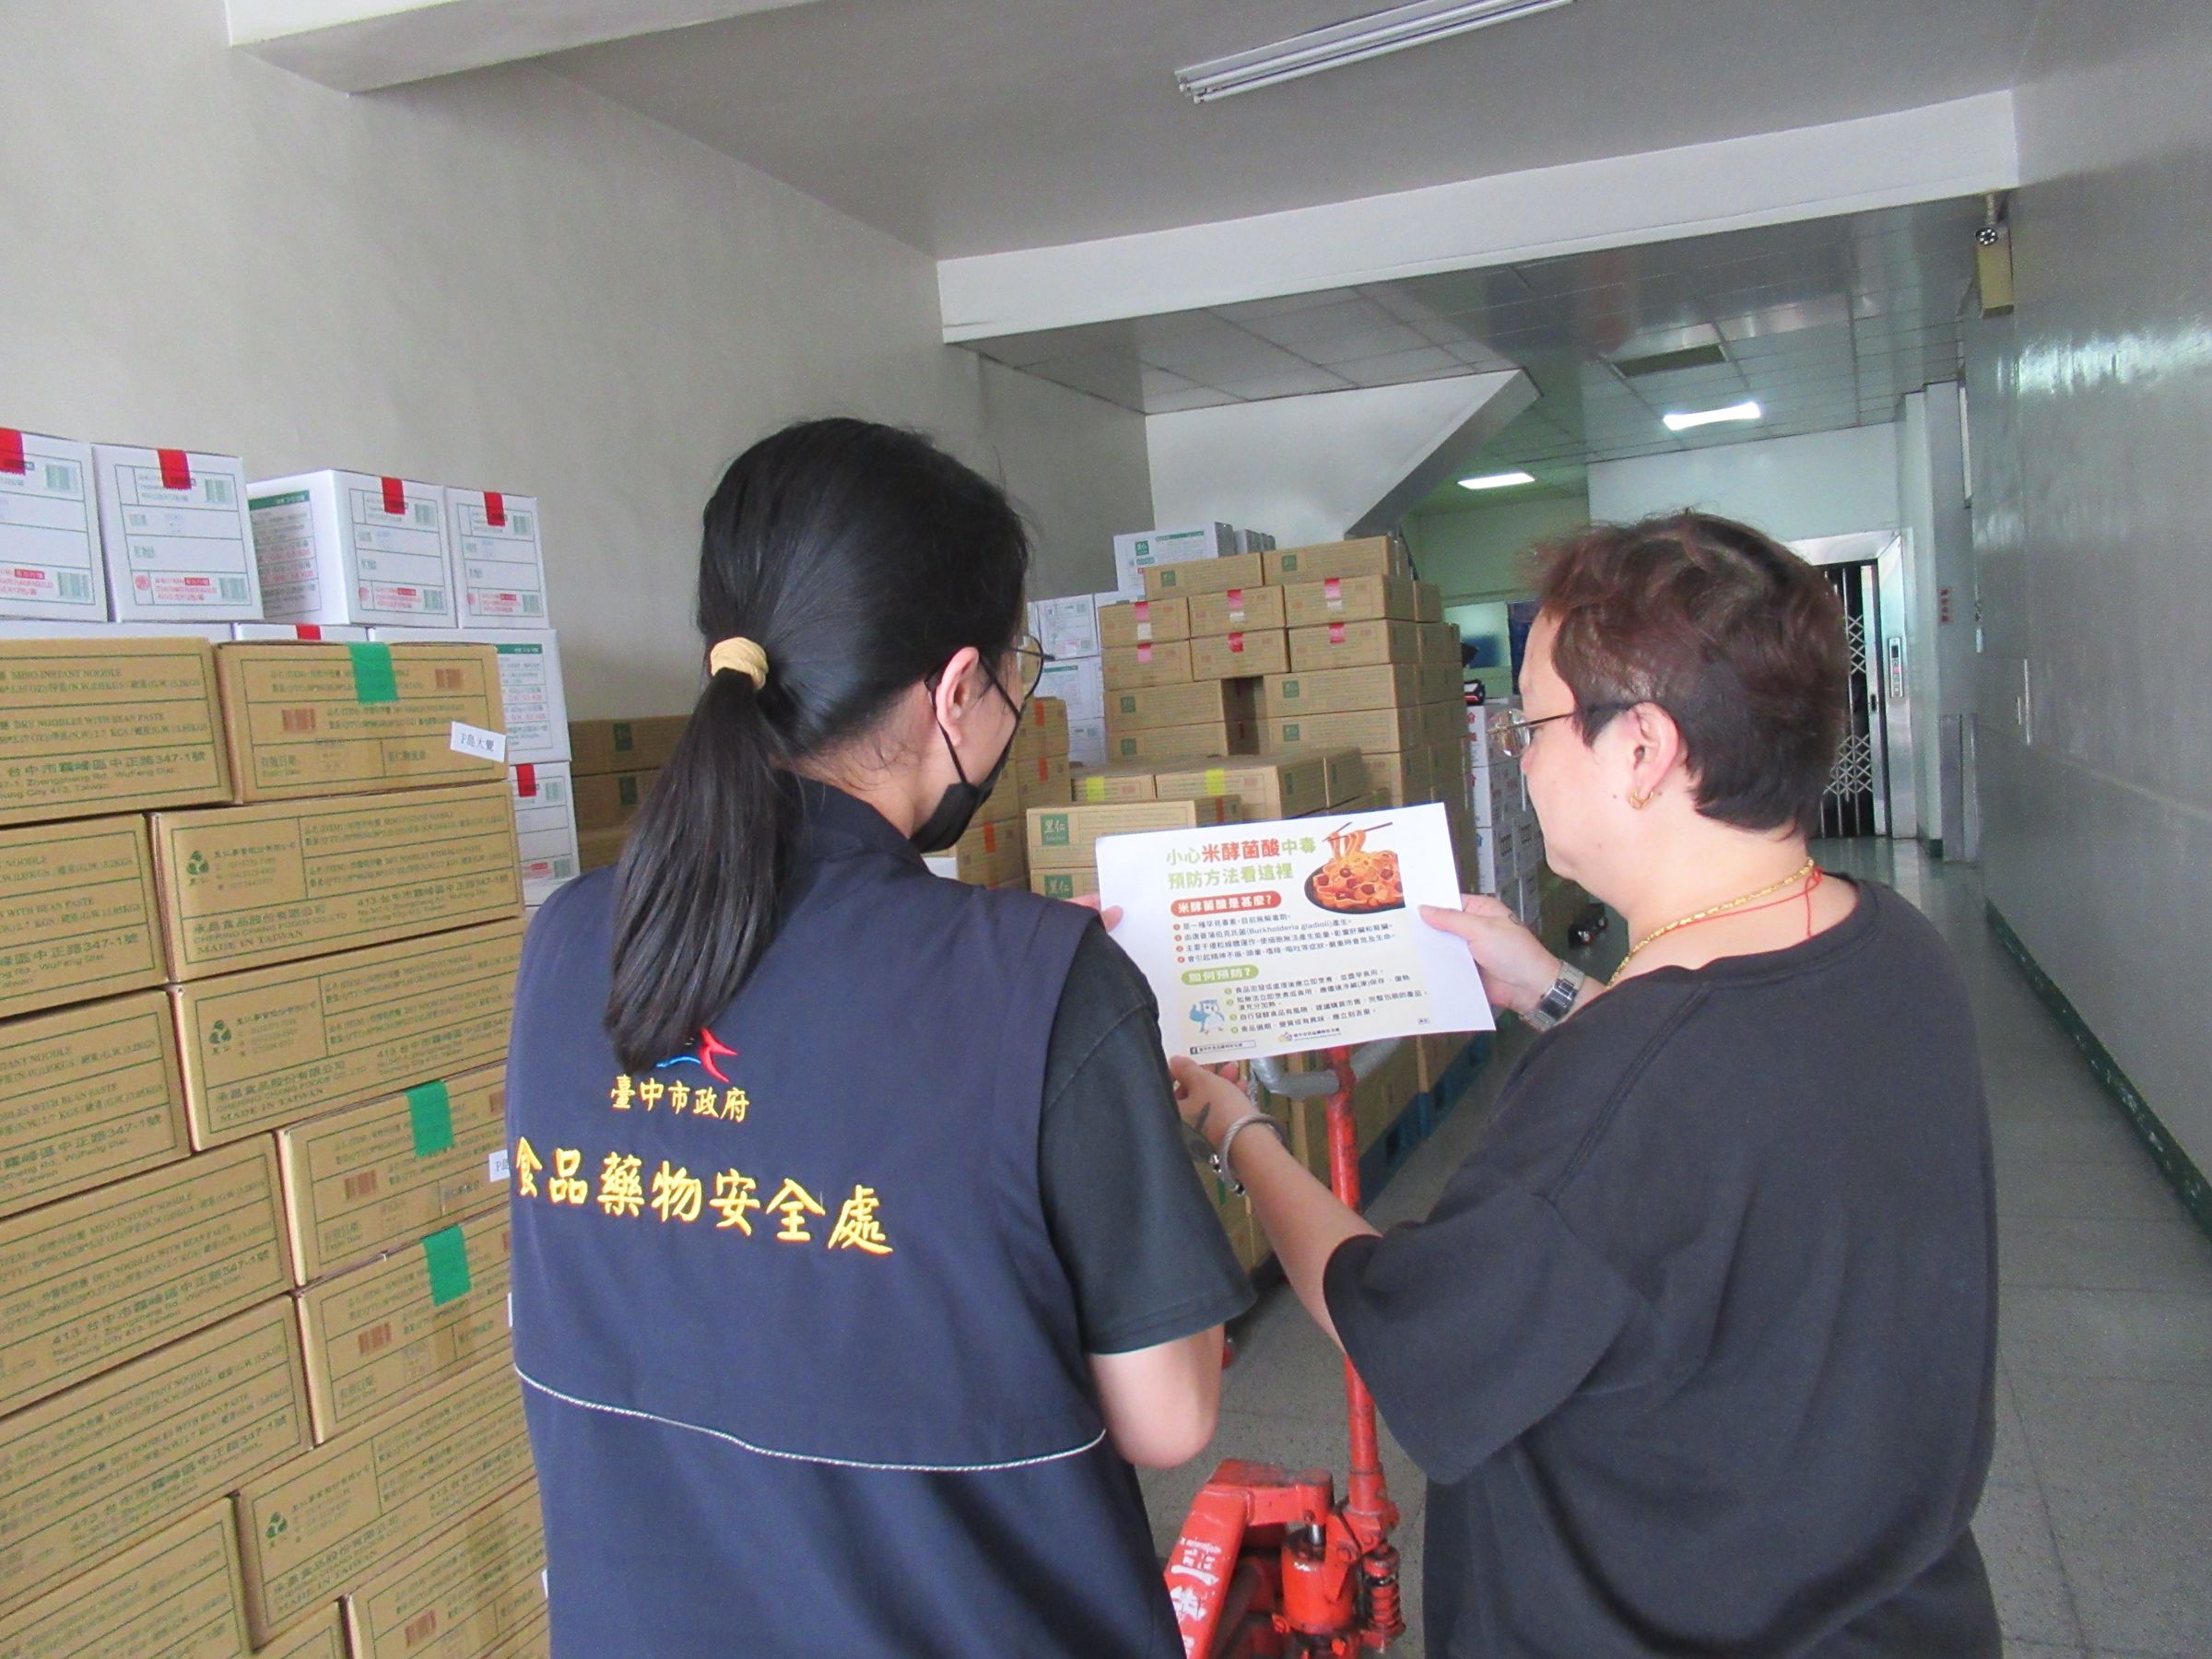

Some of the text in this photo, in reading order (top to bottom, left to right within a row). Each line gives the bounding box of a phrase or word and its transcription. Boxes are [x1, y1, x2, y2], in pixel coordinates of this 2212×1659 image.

[1044, 818, 1066, 834] 里仁
[1166, 837, 1316, 866] 小心米酵菌酸中毒
[1168, 863, 1294, 890] 預防方法看這裡
[196, 930, 304, 956] MADE IN TAIWAN
[610, 1075, 750, 1123] 臺中市政府
[516, 1136, 894, 1256] 食品藥物安全處
